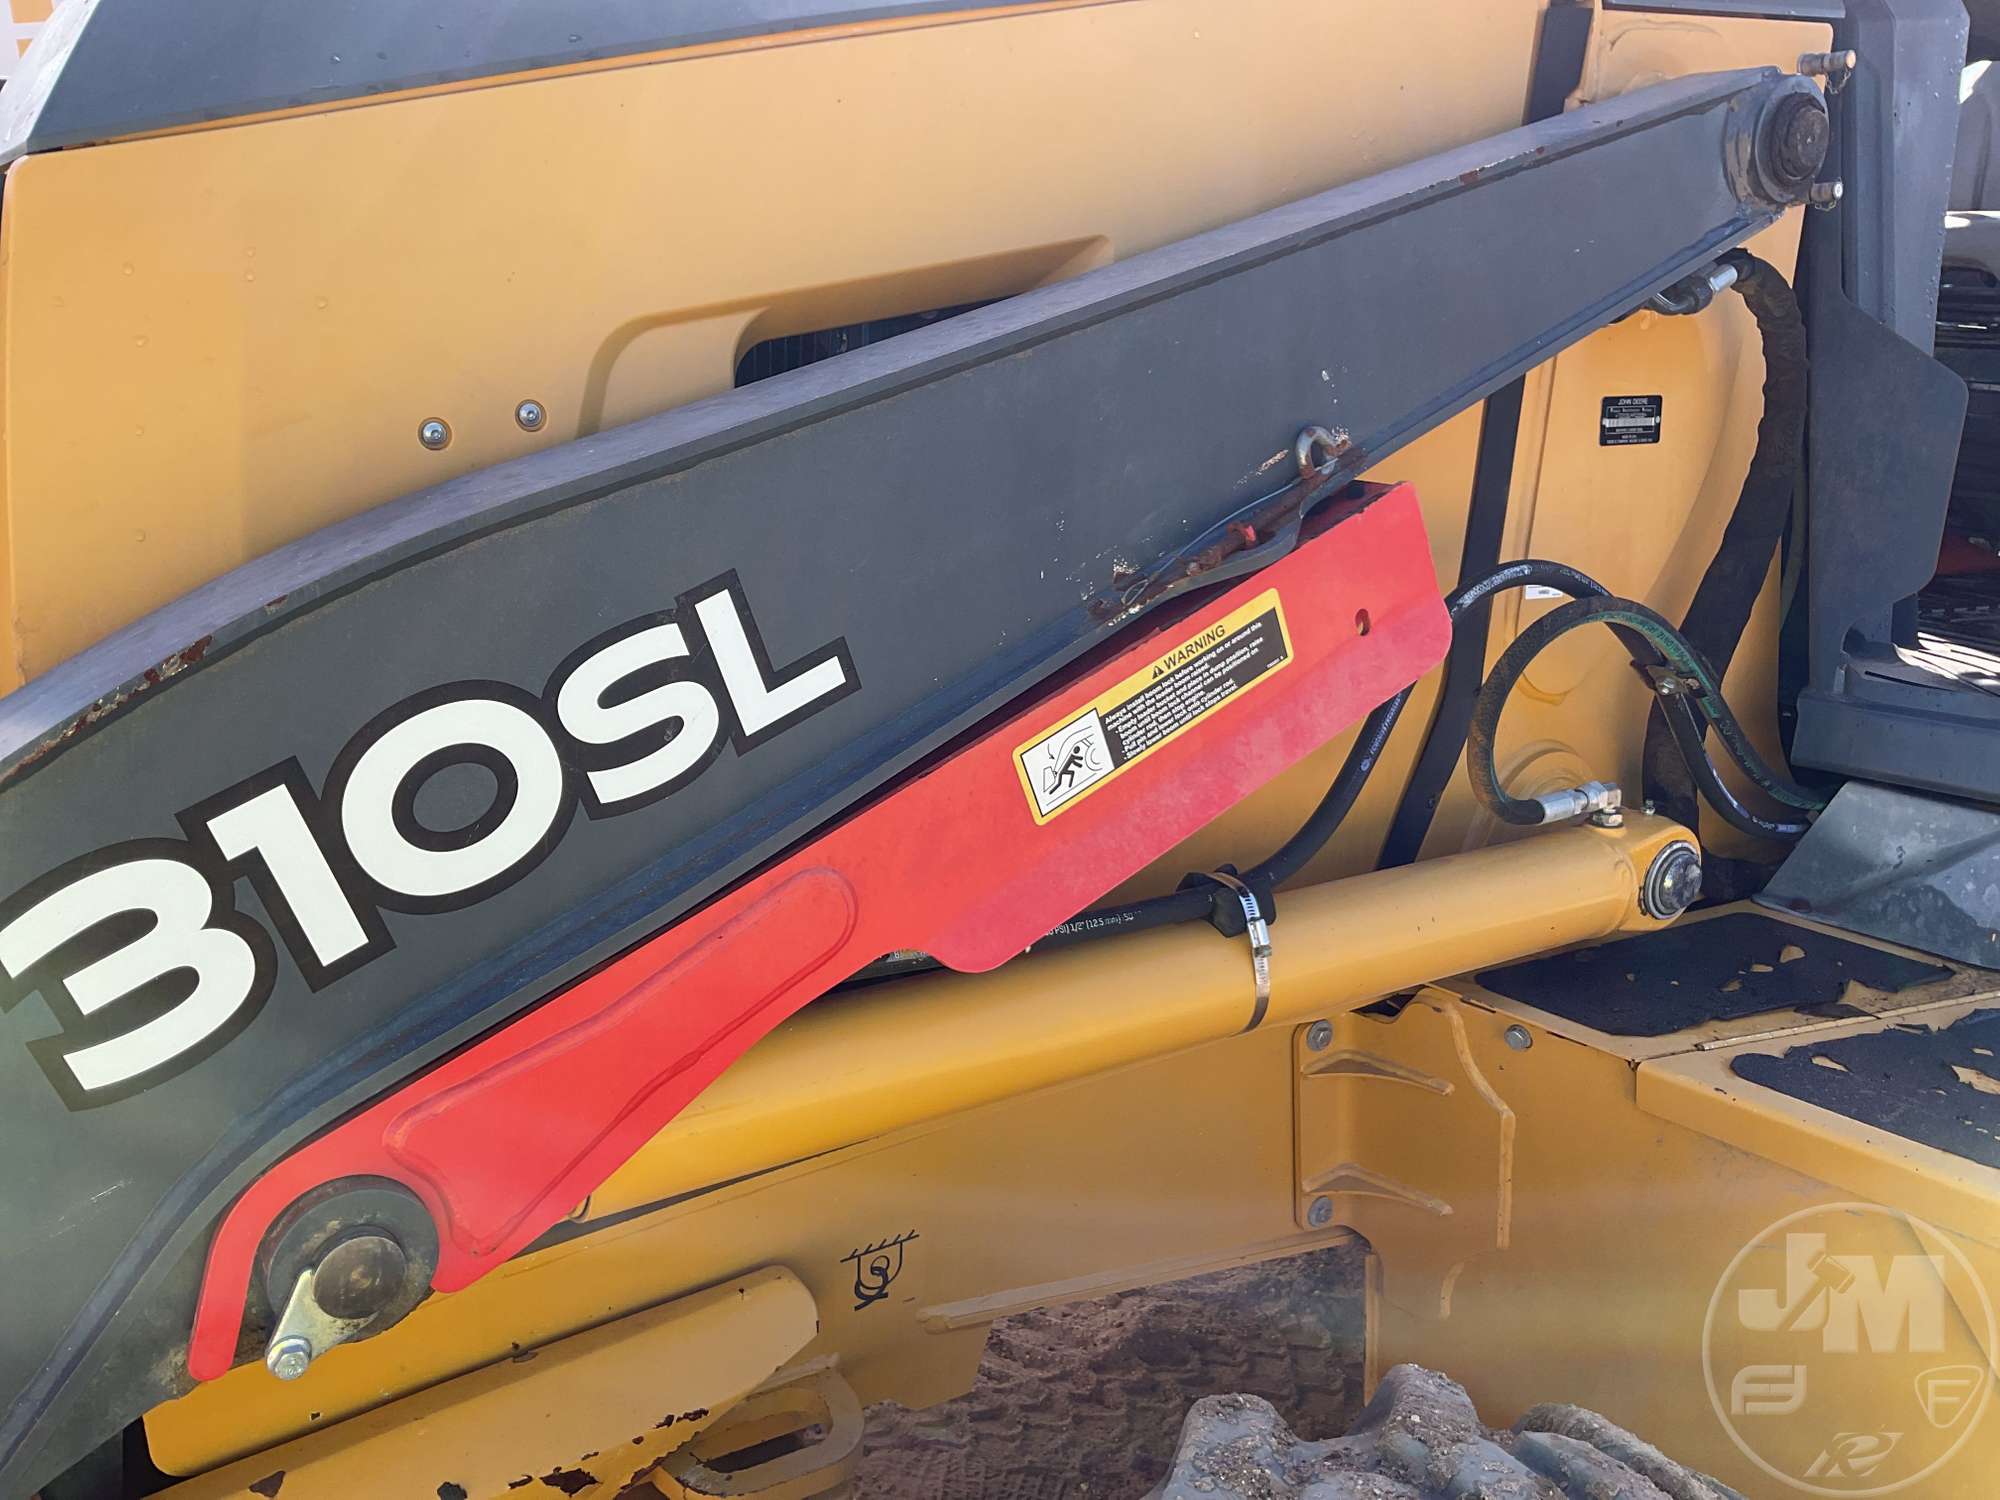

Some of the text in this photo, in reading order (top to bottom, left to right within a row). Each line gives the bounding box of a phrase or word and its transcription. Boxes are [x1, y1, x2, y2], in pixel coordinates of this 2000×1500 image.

[1104, 620, 1262, 725] Always install boom lock before working on or around this
[1117, 716, 1137, 733] Empty
[1136, 705, 1155, 720] loader
[1155, 692, 1175, 708] bucket
[1175, 685, 1187, 695] and
[1187, 675, 1202, 689] place
[1209, 660, 1225, 675] dump
[1225, 645, 1249, 665] position,
[1248, 636, 1263, 649] raise
[1163, 624, 1227, 670] WARNING
[1106, 662, 1209, 731] machine with the loader boom raised.
[1119, 647, 1259, 739] boom until boom lock channel can be positioned on
[1121, 689, 1205, 747] cylinder rod, then stop engine.
[1124, 678, 1234, 752] Pull pin and lower lock onto cylinder rod.
[1126, 683, 1237, 759] Slowly lower boom until lock stops travel.
[0, 589, 847, 1092] 310SL
